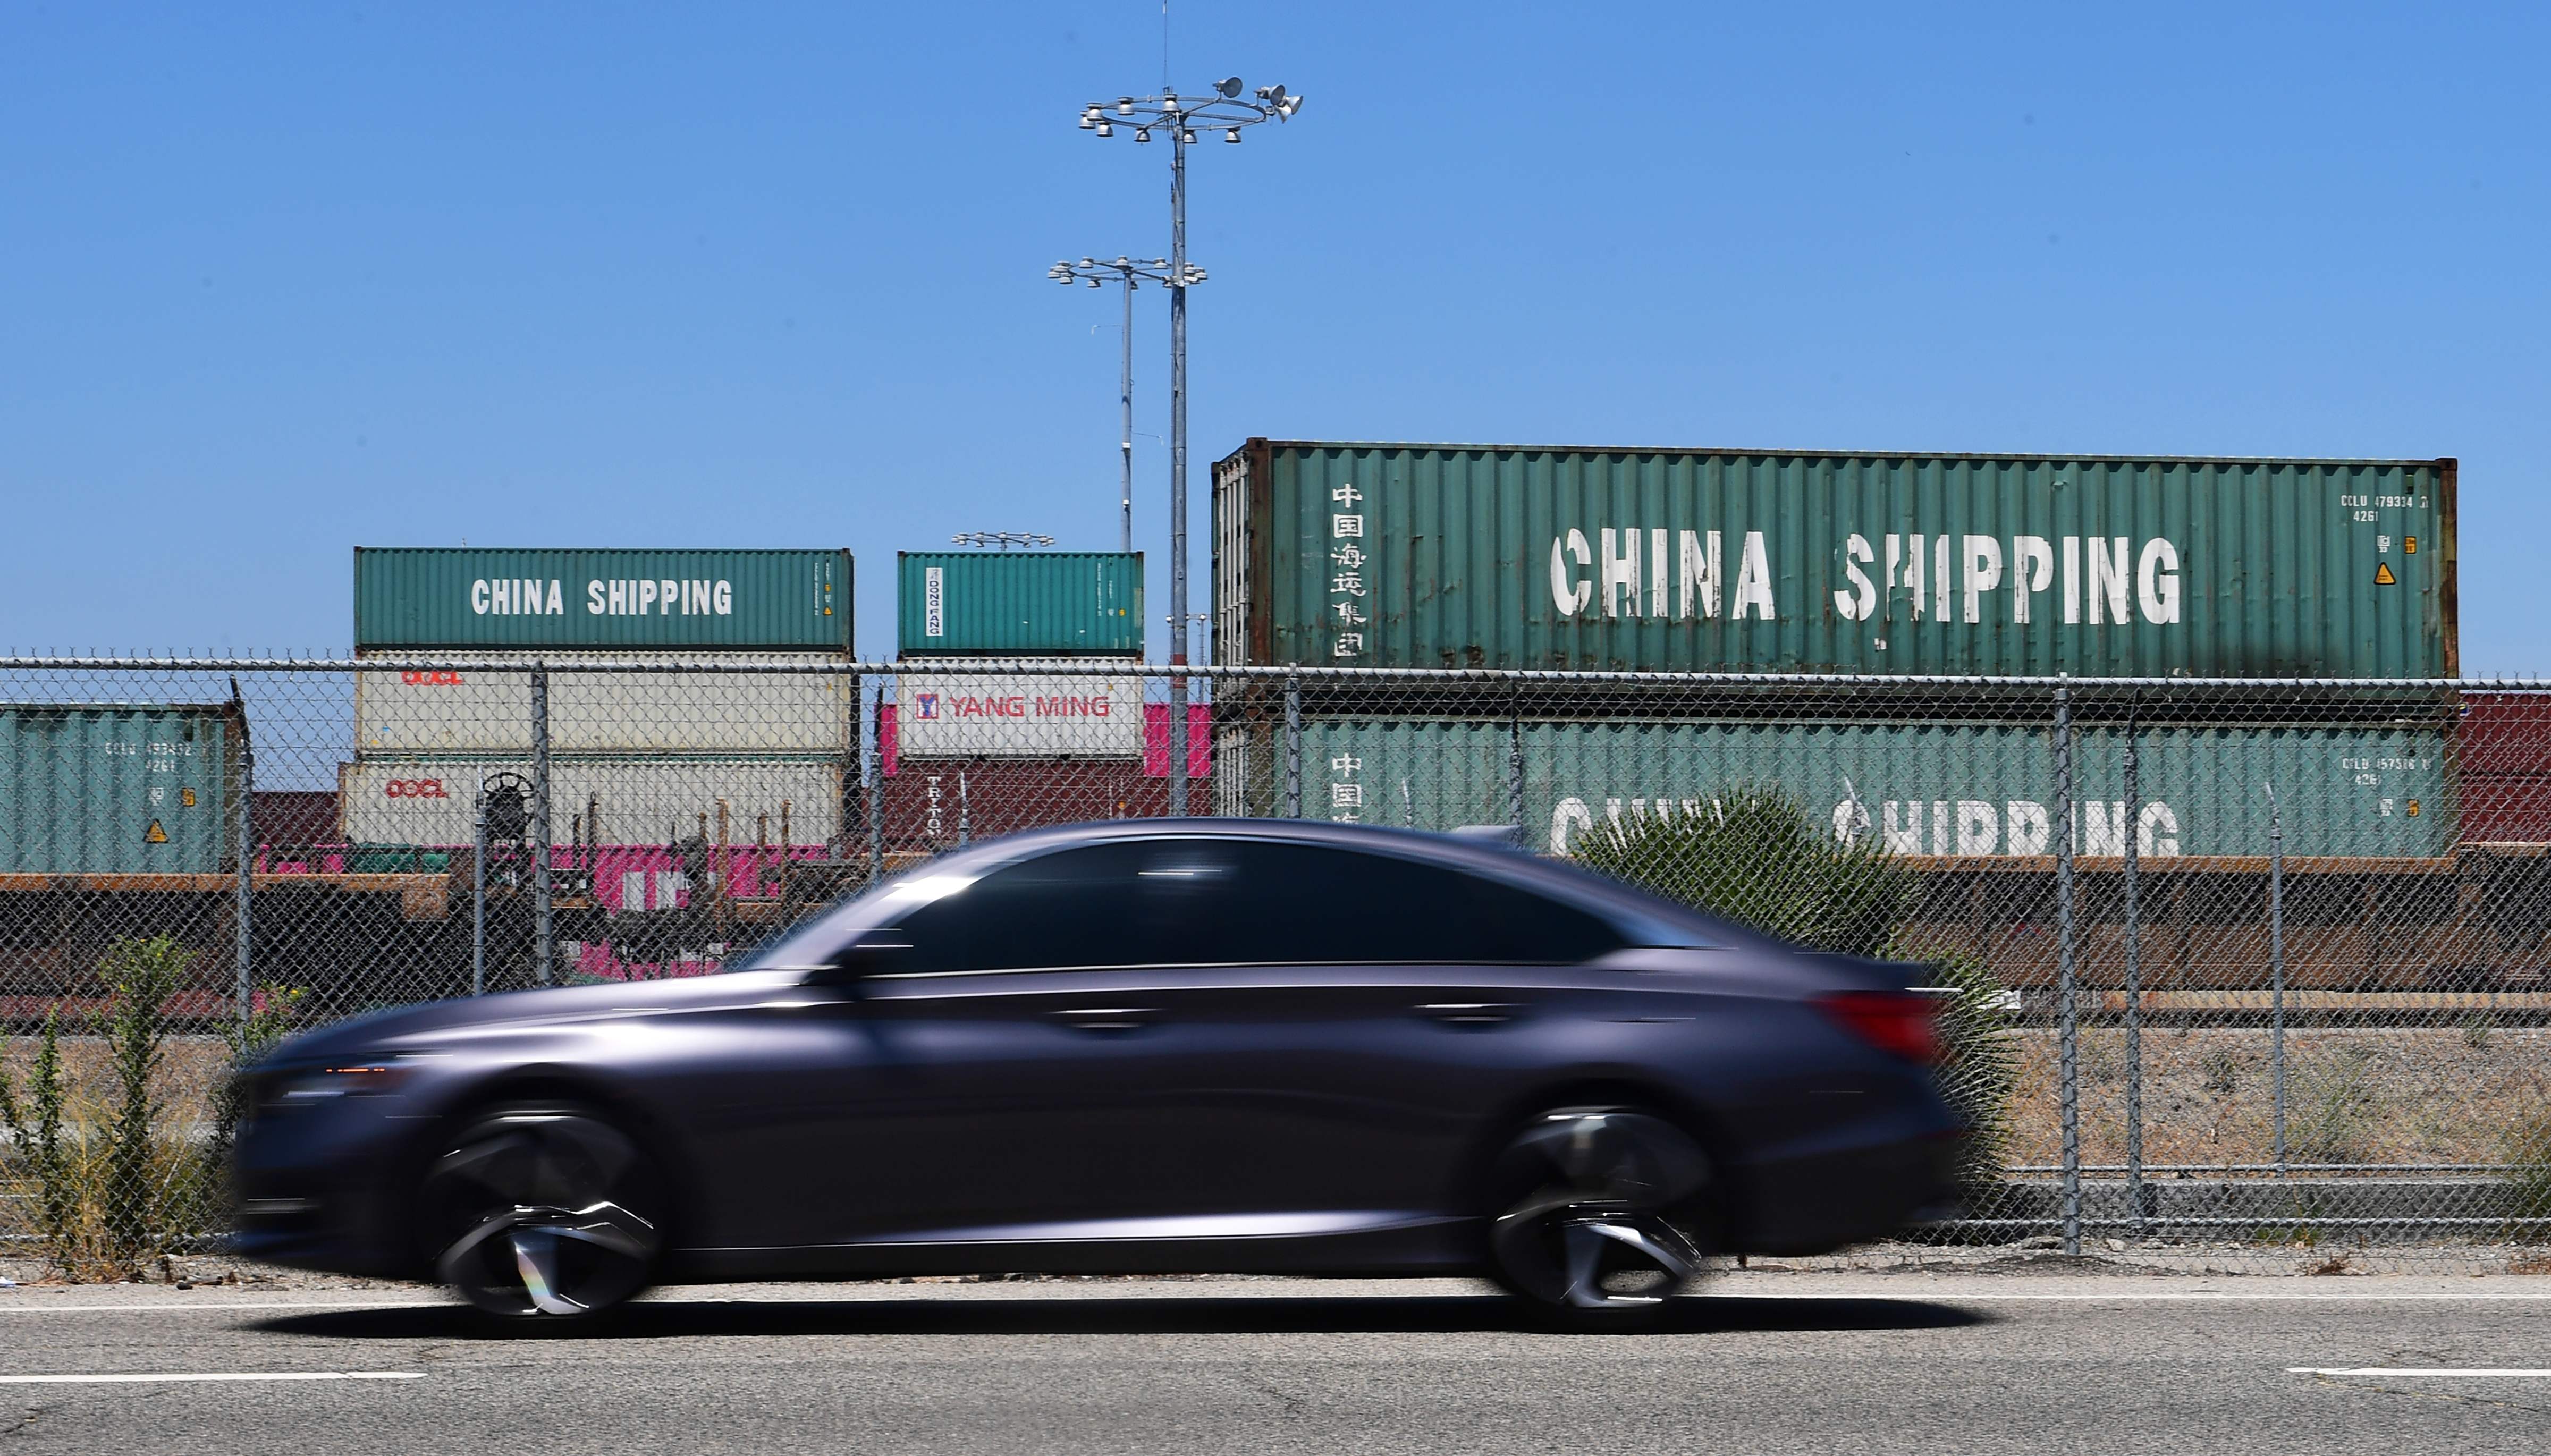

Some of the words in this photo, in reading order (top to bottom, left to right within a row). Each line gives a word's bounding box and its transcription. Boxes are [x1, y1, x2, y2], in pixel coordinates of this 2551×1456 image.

[2341, 495, 2367, 506] CCLU
[2375, 496, 2413, 507] 479334
[1551, 528, 1775, 620] CHINA
[1834, 533, 2180, 625] SHIPPING
[471, 579, 563, 615] CHINA
[587, 579, 731, 615] SHIPPING
[949, 696, 1025, 717] YANG
[1036, 696, 1109, 717] MING
